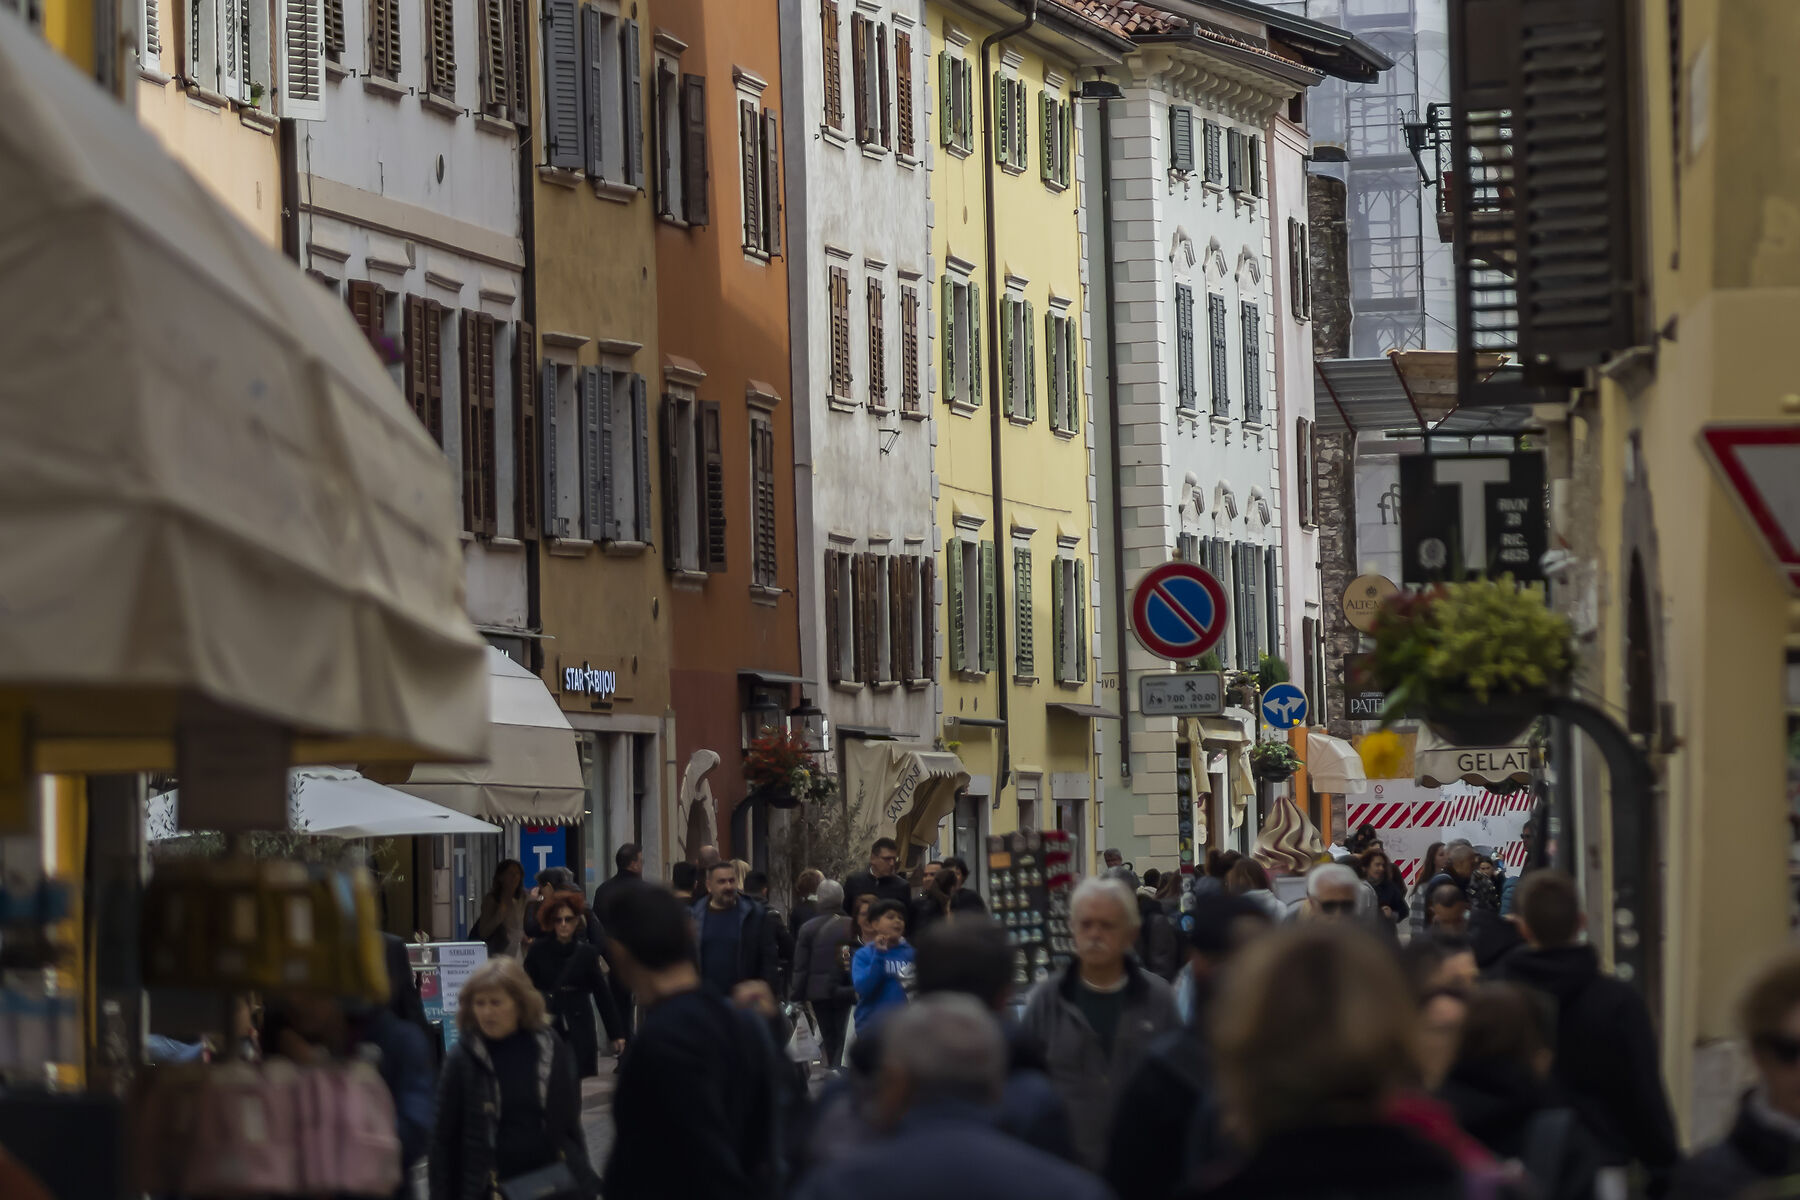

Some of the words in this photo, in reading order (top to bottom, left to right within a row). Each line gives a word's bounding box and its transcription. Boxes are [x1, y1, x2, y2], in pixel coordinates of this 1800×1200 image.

[1434, 458, 1510, 569] T
[566, 667, 585, 691] STAR
[594, 670, 616, 700] BIJOU
[1458, 752, 1528, 771] GELAT
[887, 764, 922, 823] SANTONI
